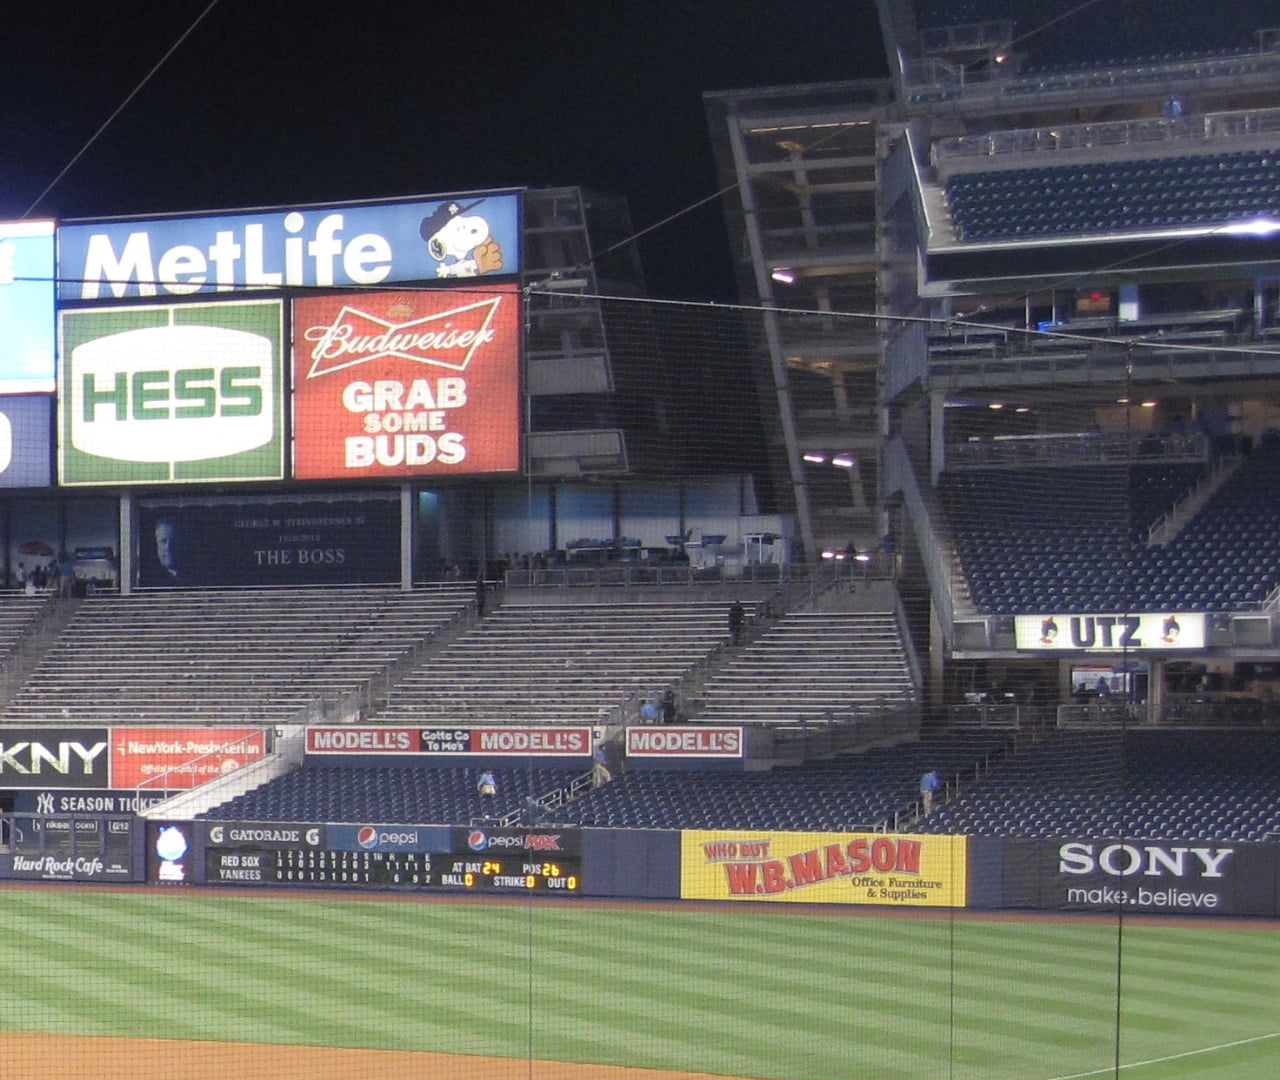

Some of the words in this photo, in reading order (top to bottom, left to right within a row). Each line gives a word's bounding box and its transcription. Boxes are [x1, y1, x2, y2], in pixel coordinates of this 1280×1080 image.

[80, 211, 393, 299] MetLife
[304, 322, 494, 361] Budweiser
[82, 366, 263, 423] HESS
[342, 377, 467, 413] GRAB
[364, 411, 445, 432] SOME
[344, 432, 466, 468] BUDS
[254, 549, 292, 565] THE
[298, 548, 346, 565] BOSS
[1070, 616, 1142, 647] UTZ
[313, 730, 410, 750] MODELL'S
[479, 731, 583, 751] MODELL'S
[421, 731, 452, 741] Gotta
[454, 731, 470, 741] Go
[630, 730, 738, 752] MODELL'S
[426, 741, 439, 750] To
[441, 741, 464, 751] Mo's
[60, 797, 114, 812] SEASON
[229, 829, 300, 842] GATORADE
[379, 831, 419, 846] pepsi
[488, 835, 523, 847] pepsi
[703, 843, 739, 859] WHO
[740, 842, 770, 857] BUT
[13, 856, 44, 872] Hard
[44, 856, 75, 875] Rock
[75, 856, 104, 876] Cafe
[221, 855, 239, 867] RED
[241, 856, 260, 867] SOX
[452, 863, 463, 873] AT
[465, 863, 482, 873] BAT
[482, 862, 501, 874] 24
[522, 864, 541, 874] POS
[542, 863, 560, 876] 26
[1058, 843, 1234, 878] SONY
[219, 869, 261, 881] YANKEES
[441, 875, 464, 886] BALL
[464, 873, 473, 886] 0
[493, 876, 526, 888] STRIKE
[526, 876, 535, 888] 0
[547, 877, 566, 889] OUT
[567, 876, 576, 889] 0
[851, 876, 886, 888] Office
[888, 877, 943, 889] Furniture
[866, 888, 877, 898] &
[879, 888, 928, 900] Supplies
[1067, 886, 1218, 909] make.believe
